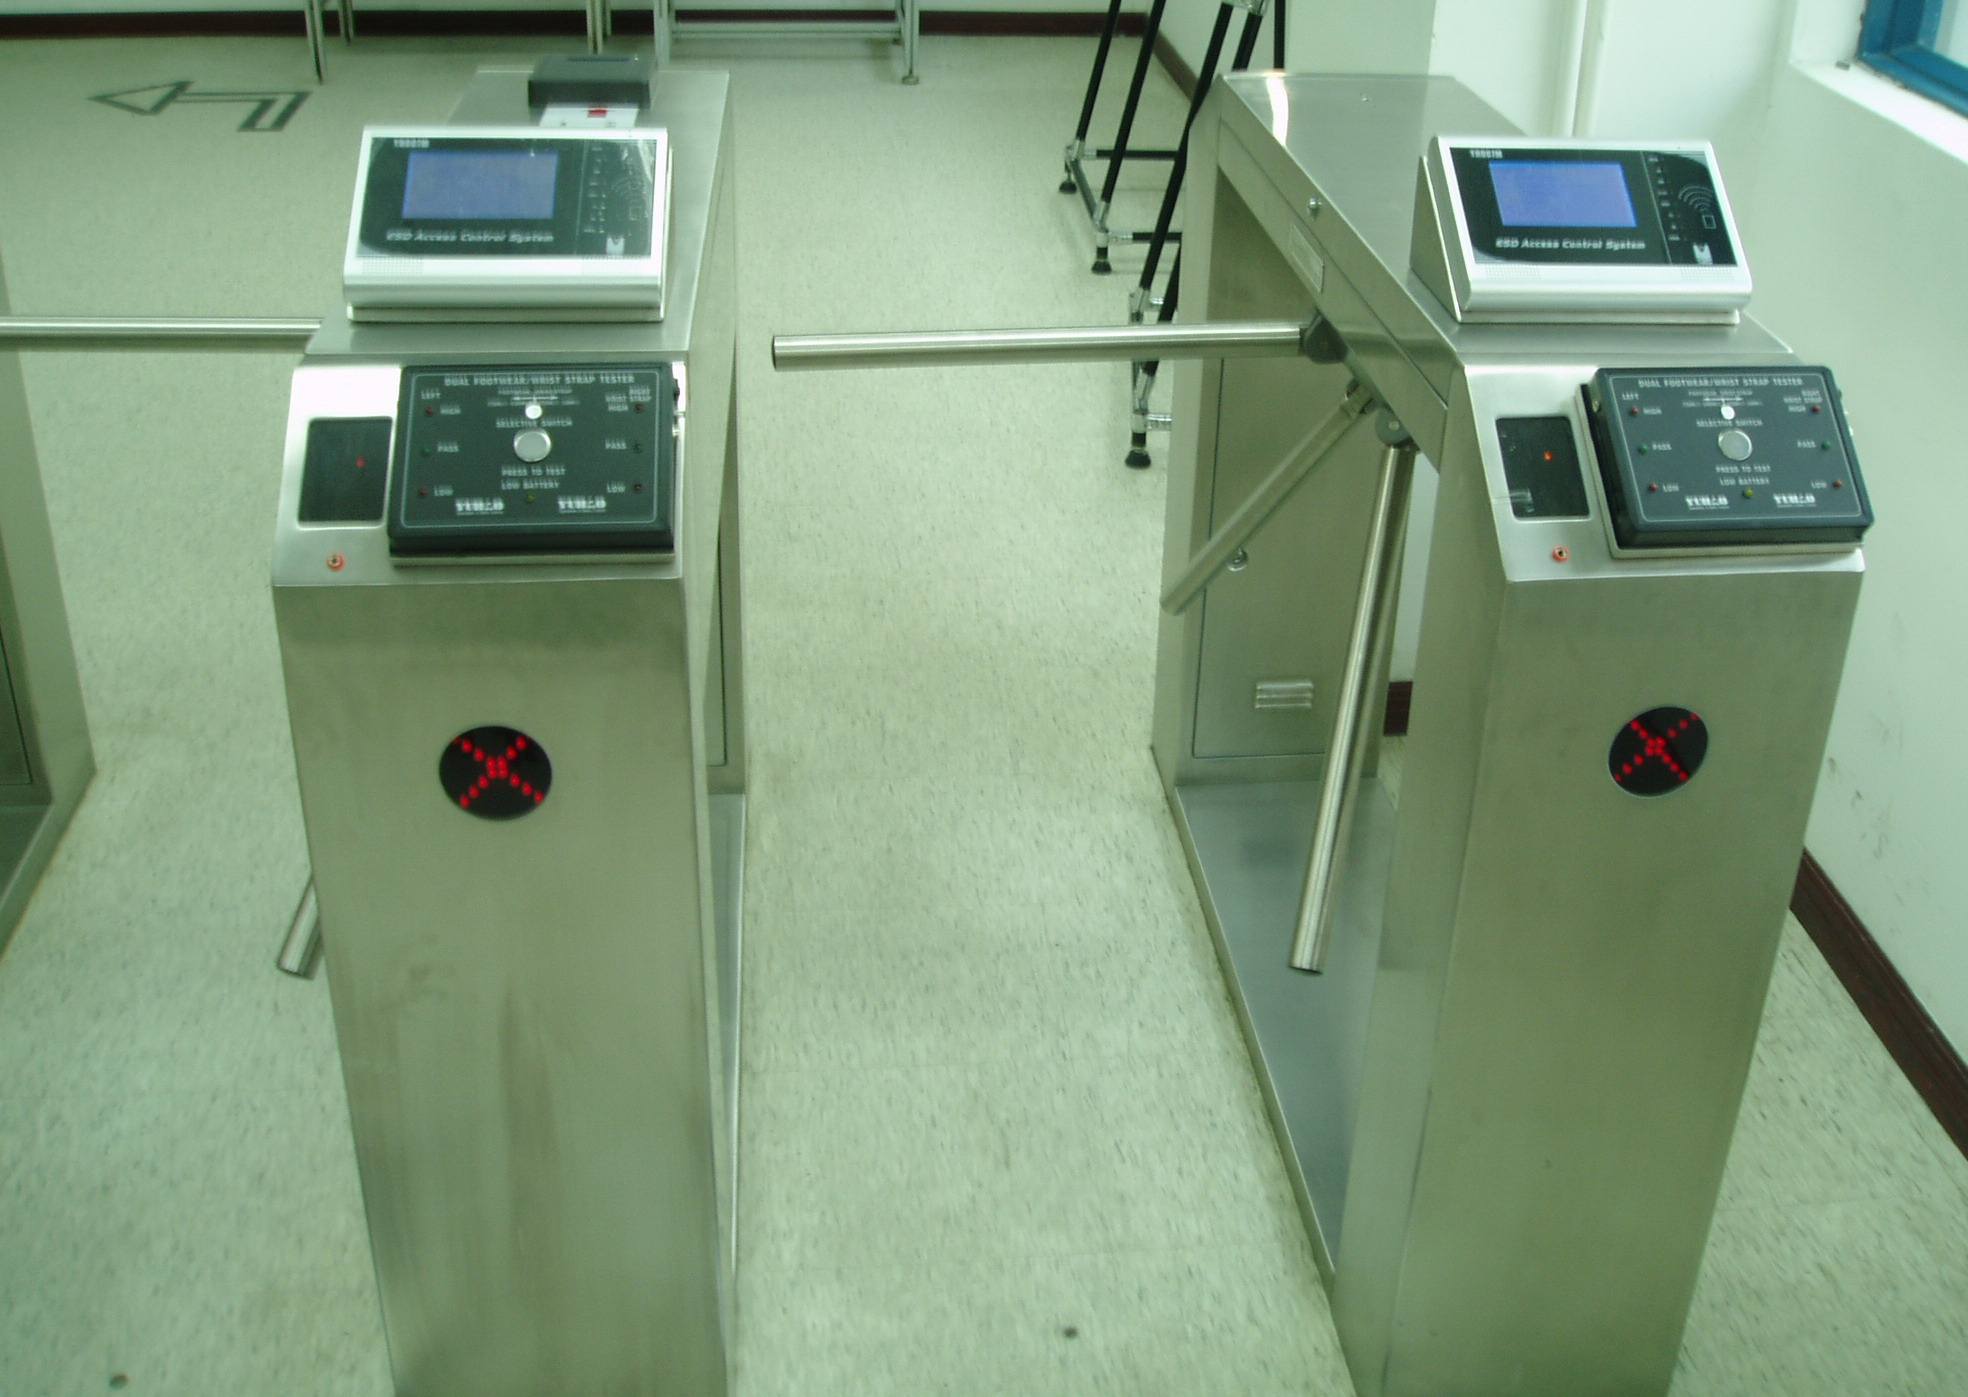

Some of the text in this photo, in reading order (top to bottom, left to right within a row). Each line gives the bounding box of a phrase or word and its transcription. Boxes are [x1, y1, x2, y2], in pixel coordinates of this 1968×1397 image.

[386, 229, 554, 243] ESD Access Control System
[1496, 237, 1646, 251] ESD Access Control System
[445, 375, 634, 386] DUAL FOOTWEAR/WRIST STRAP TESTER
[1639, 377, 1803, 388] DUAL FOOTWEAR/WRIST STRAP TESTER
[421, 390, 440, 400] LEFT
[1622, 392, 1639, 401] LEFT
[542, 417, 572, 427] SWITCH
[438, 442, 459, 453] PASS
[605, 440, 626, 450] PASS
[1652, 443, 1672, 452] PASS
[1797, 440, 1816, 449] PASS
[502, 466, 565, 477] PRESS TO TEST
[1716, 464, 1771, 473] PRESS TO TEST
[502, 480, 560, 490] LOW BATTERY
[1720, 477, 1769, 486] LOW BATTERY
[1811, 480, 1827, 489] LOW
[435, 485, 453, 496] LOW
[607, 483, 625, 493] LOW
